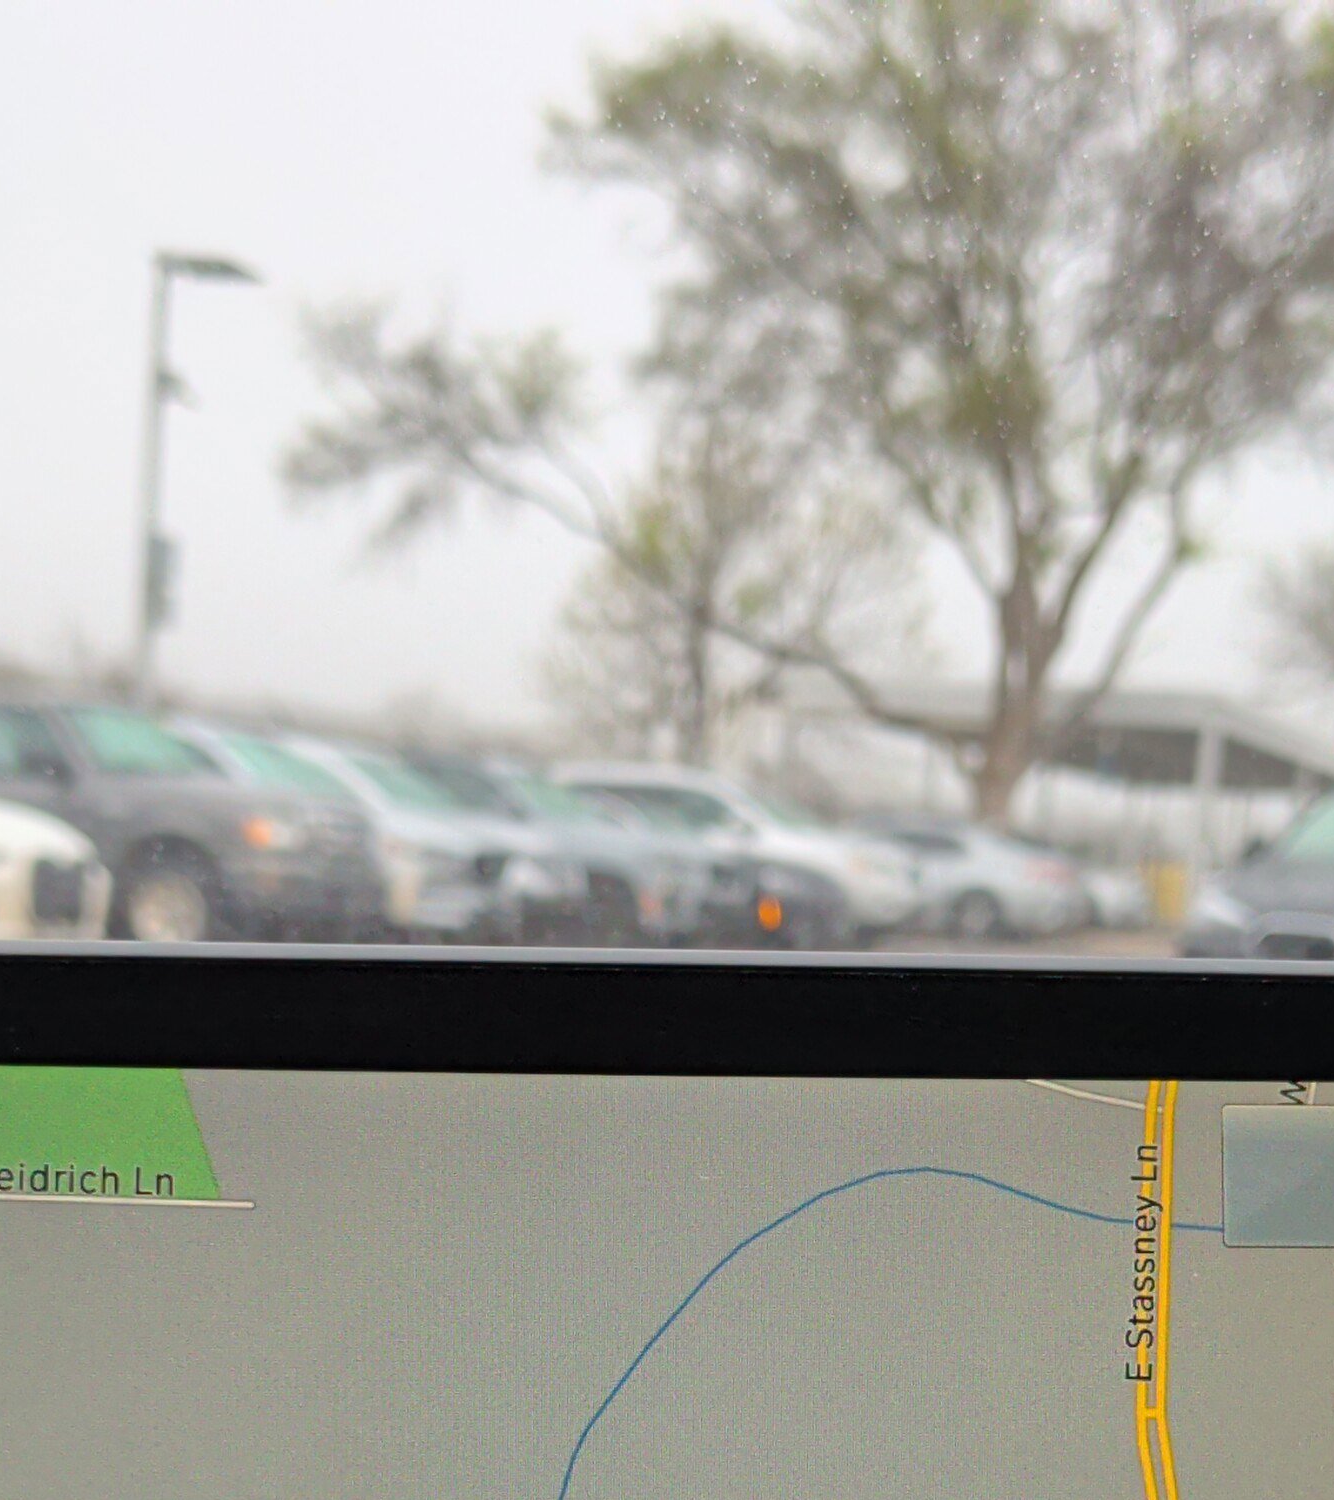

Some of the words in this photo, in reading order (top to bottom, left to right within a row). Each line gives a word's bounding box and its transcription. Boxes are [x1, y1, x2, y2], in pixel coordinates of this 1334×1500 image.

[1130, 1144, 1159, 1183] Ln
[134, 1166, 176, 1197] Ln
[1125, 1194, 1164, 1350] Stassney
[1124, 1362, 1154, 1383] E
